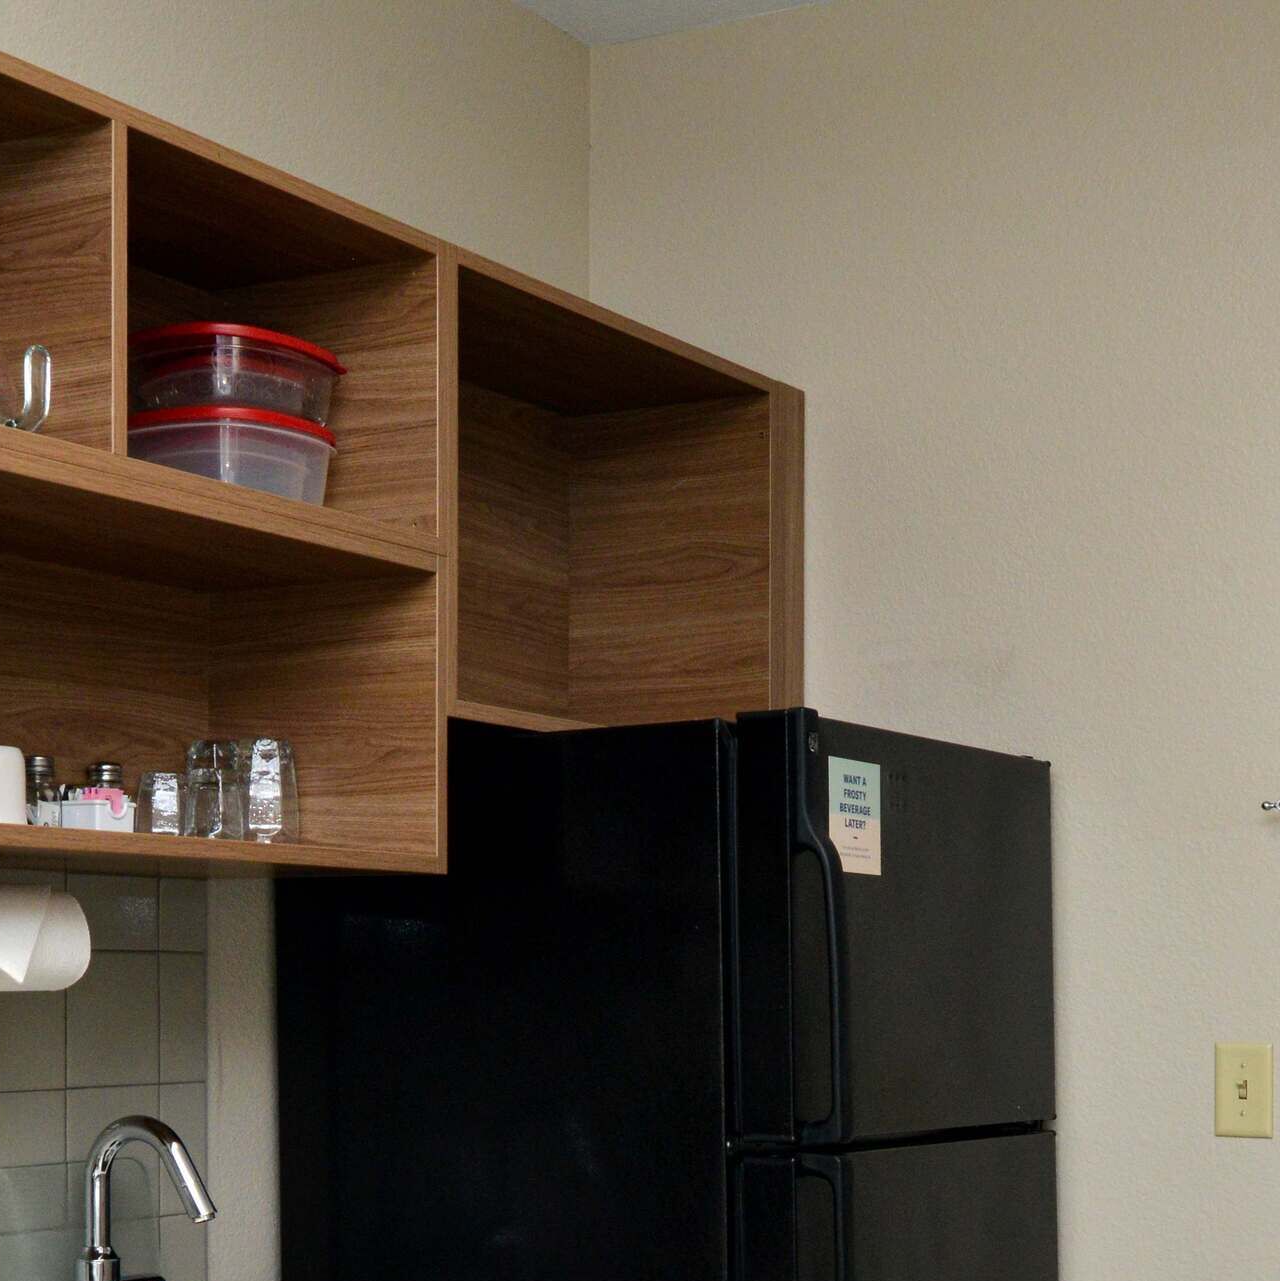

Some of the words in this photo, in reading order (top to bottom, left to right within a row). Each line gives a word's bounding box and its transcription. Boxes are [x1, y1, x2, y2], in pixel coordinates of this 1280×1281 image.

[843, 774, 861, 786] WANT
[862, 776, 867, 787] A
[843, 788, 866, 801] FROSTY
[839, 802, 871, 817] BEVERAGE
[844, 818, 866, 830] LATER?
